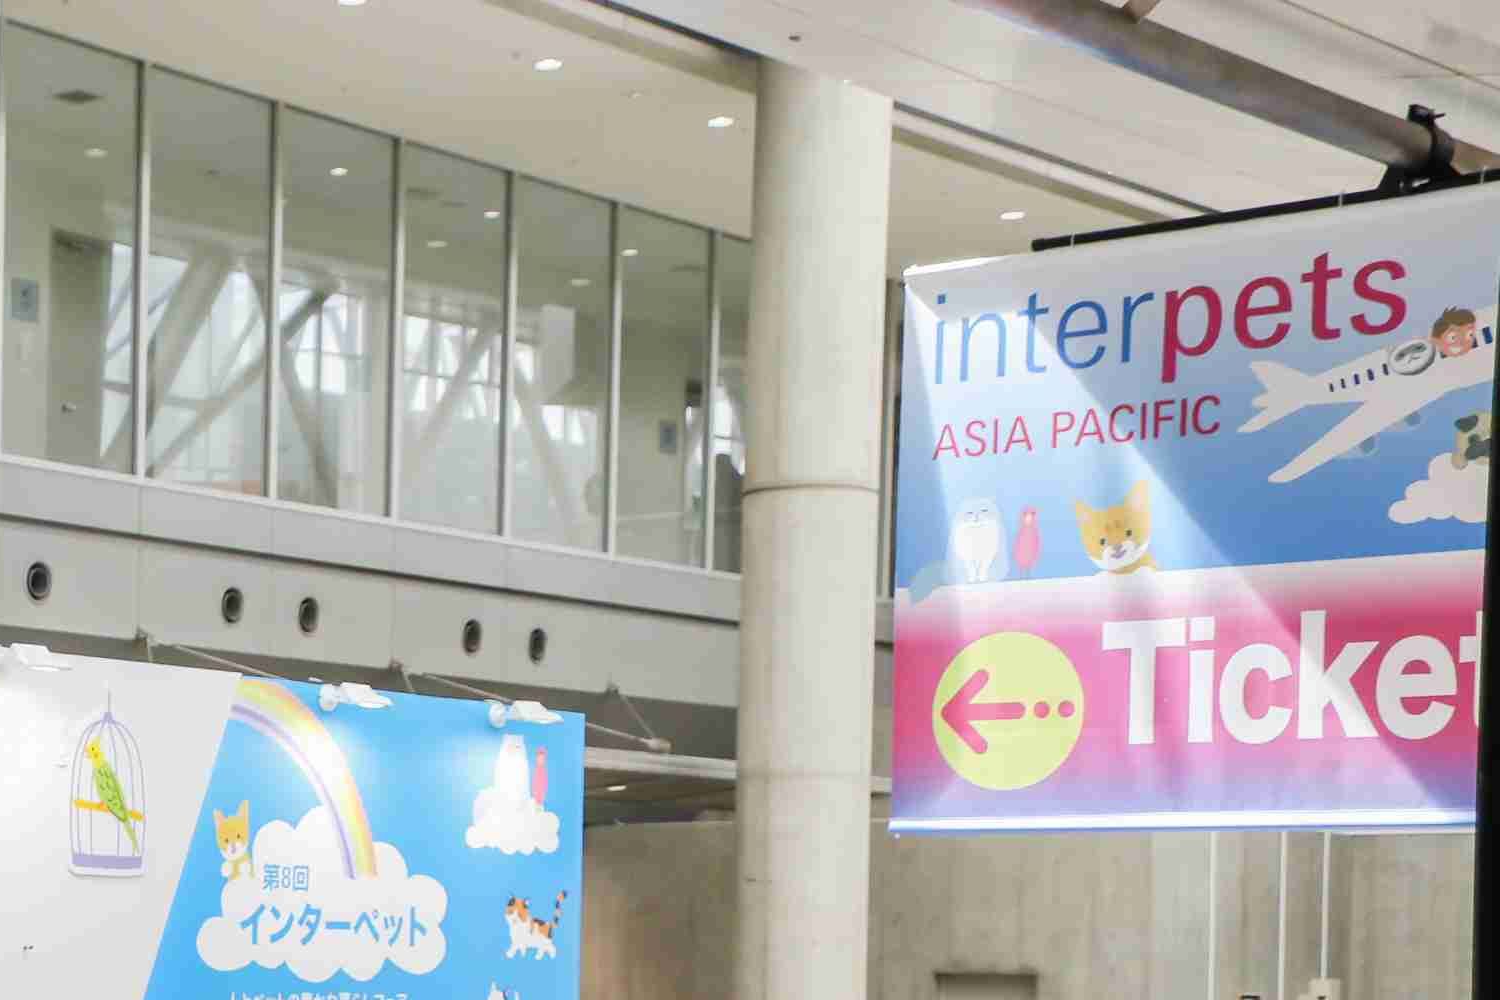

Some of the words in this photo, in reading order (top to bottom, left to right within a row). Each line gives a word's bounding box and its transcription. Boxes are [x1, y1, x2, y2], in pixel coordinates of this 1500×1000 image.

[933, 251, 1408, 385] interpets
[932, 415, 1036, 461] ASIA
[1051, 394, 1222, 450] PACIFIC
[262, 863, 310, 891] 第8回
[240, 903, 428, 947] インターペット
